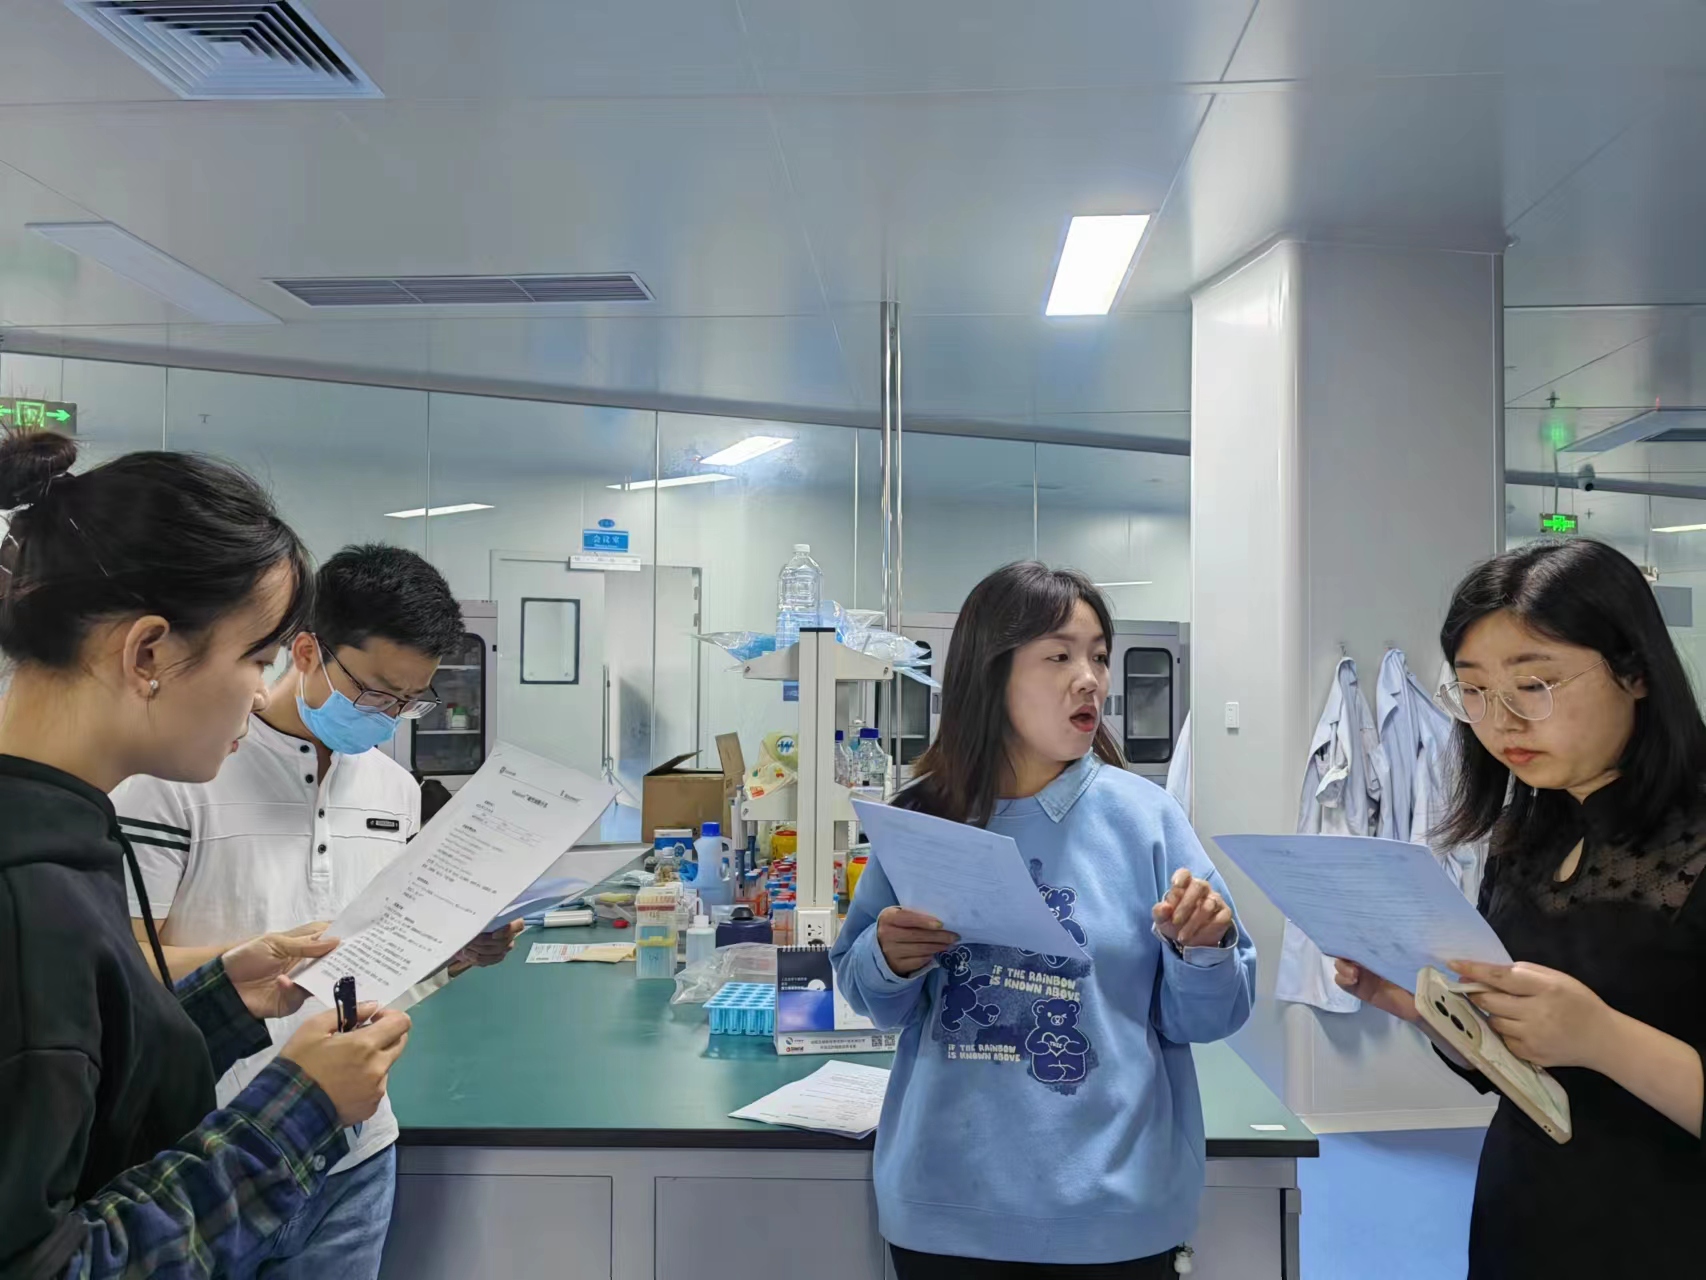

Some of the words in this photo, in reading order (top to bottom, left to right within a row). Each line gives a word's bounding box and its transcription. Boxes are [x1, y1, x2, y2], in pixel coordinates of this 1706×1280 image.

[1007, 968, 1026, 979] THE
[1004, 978, 1043, 995] KNOWN
[1045, 986, 1081, 1002] ABOVE
[960, 1044, 976, 1052] THE
[959, 1052, 991, 1060] KNOWN
[993, 1053, 1021, 1062] ABOVE
